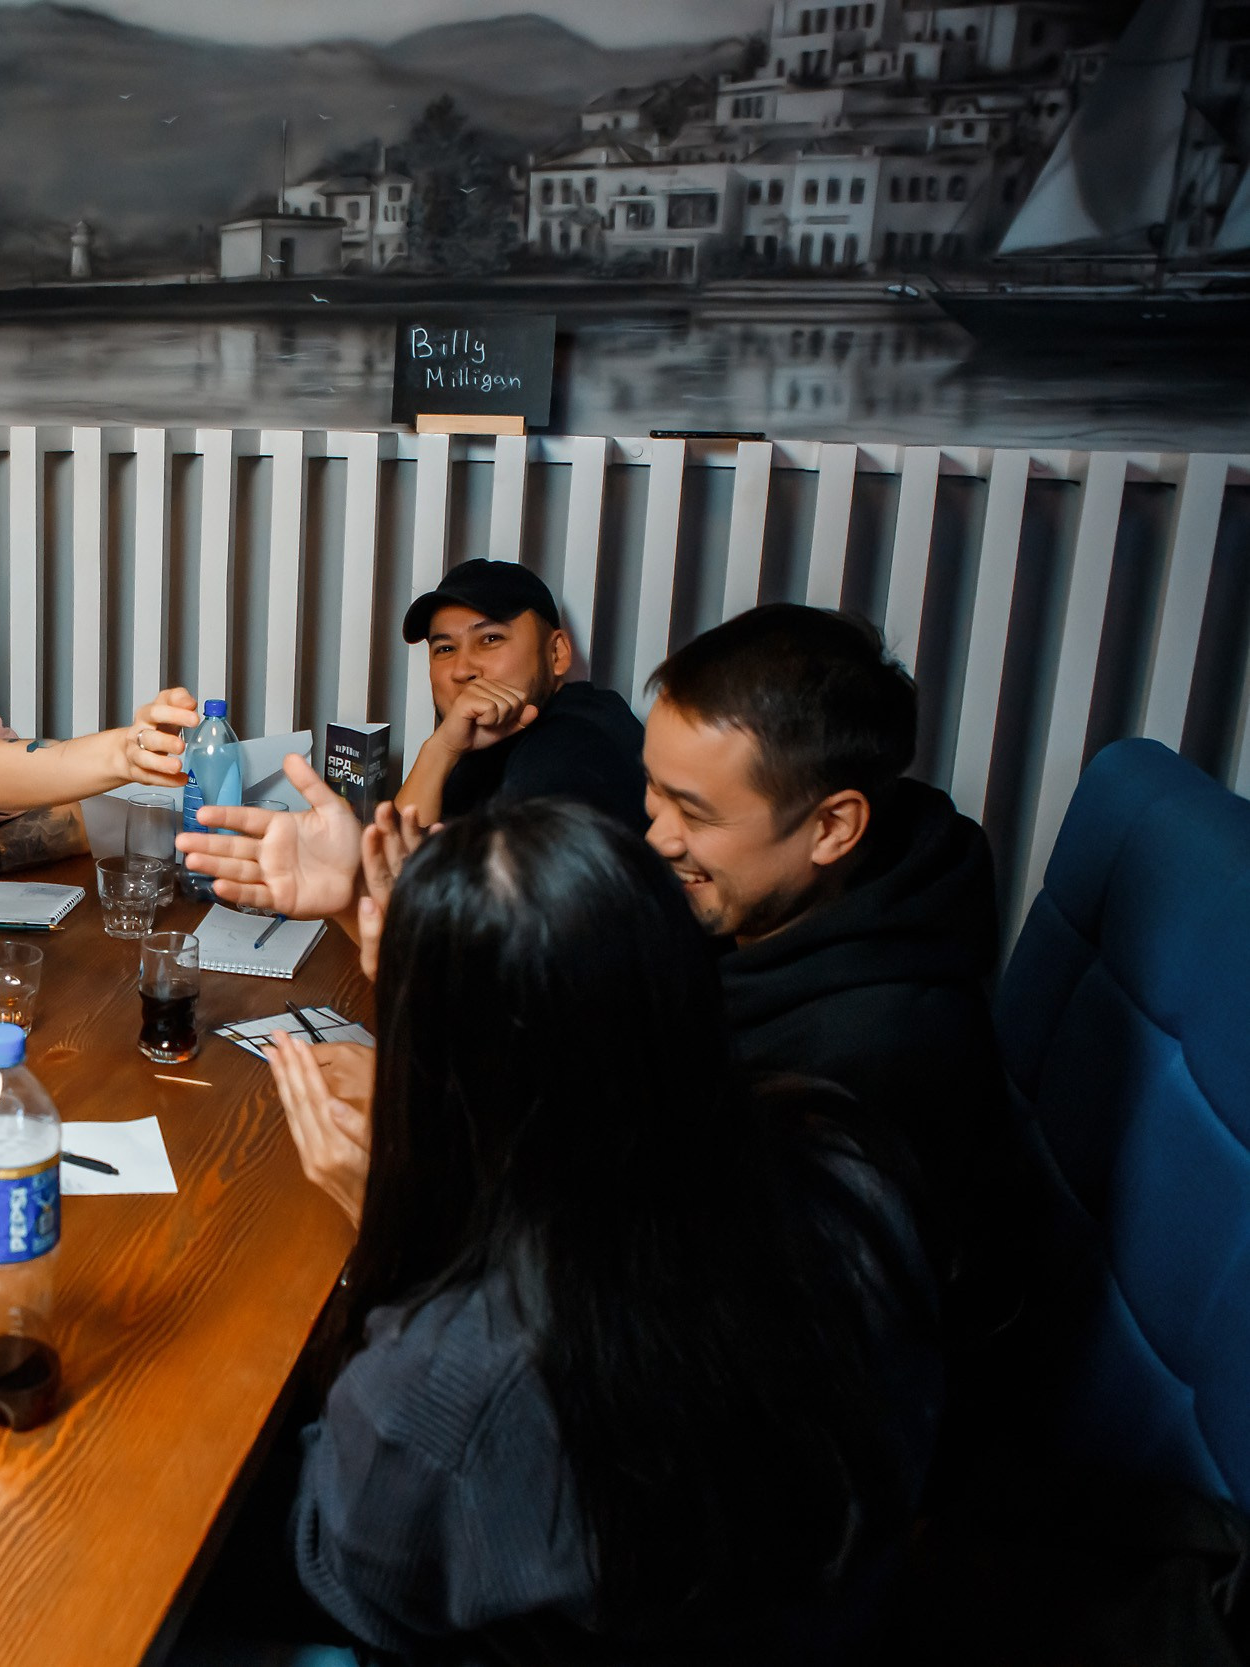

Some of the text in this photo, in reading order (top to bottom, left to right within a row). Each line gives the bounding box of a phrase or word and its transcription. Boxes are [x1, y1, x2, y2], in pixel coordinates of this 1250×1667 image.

[411, 327, 485, 364] Billy
[426, 366, 521, 393] Milligan
[328, 755, 352, 772] ЯРД
[327, 766, 364, 787] ВИСКИ
